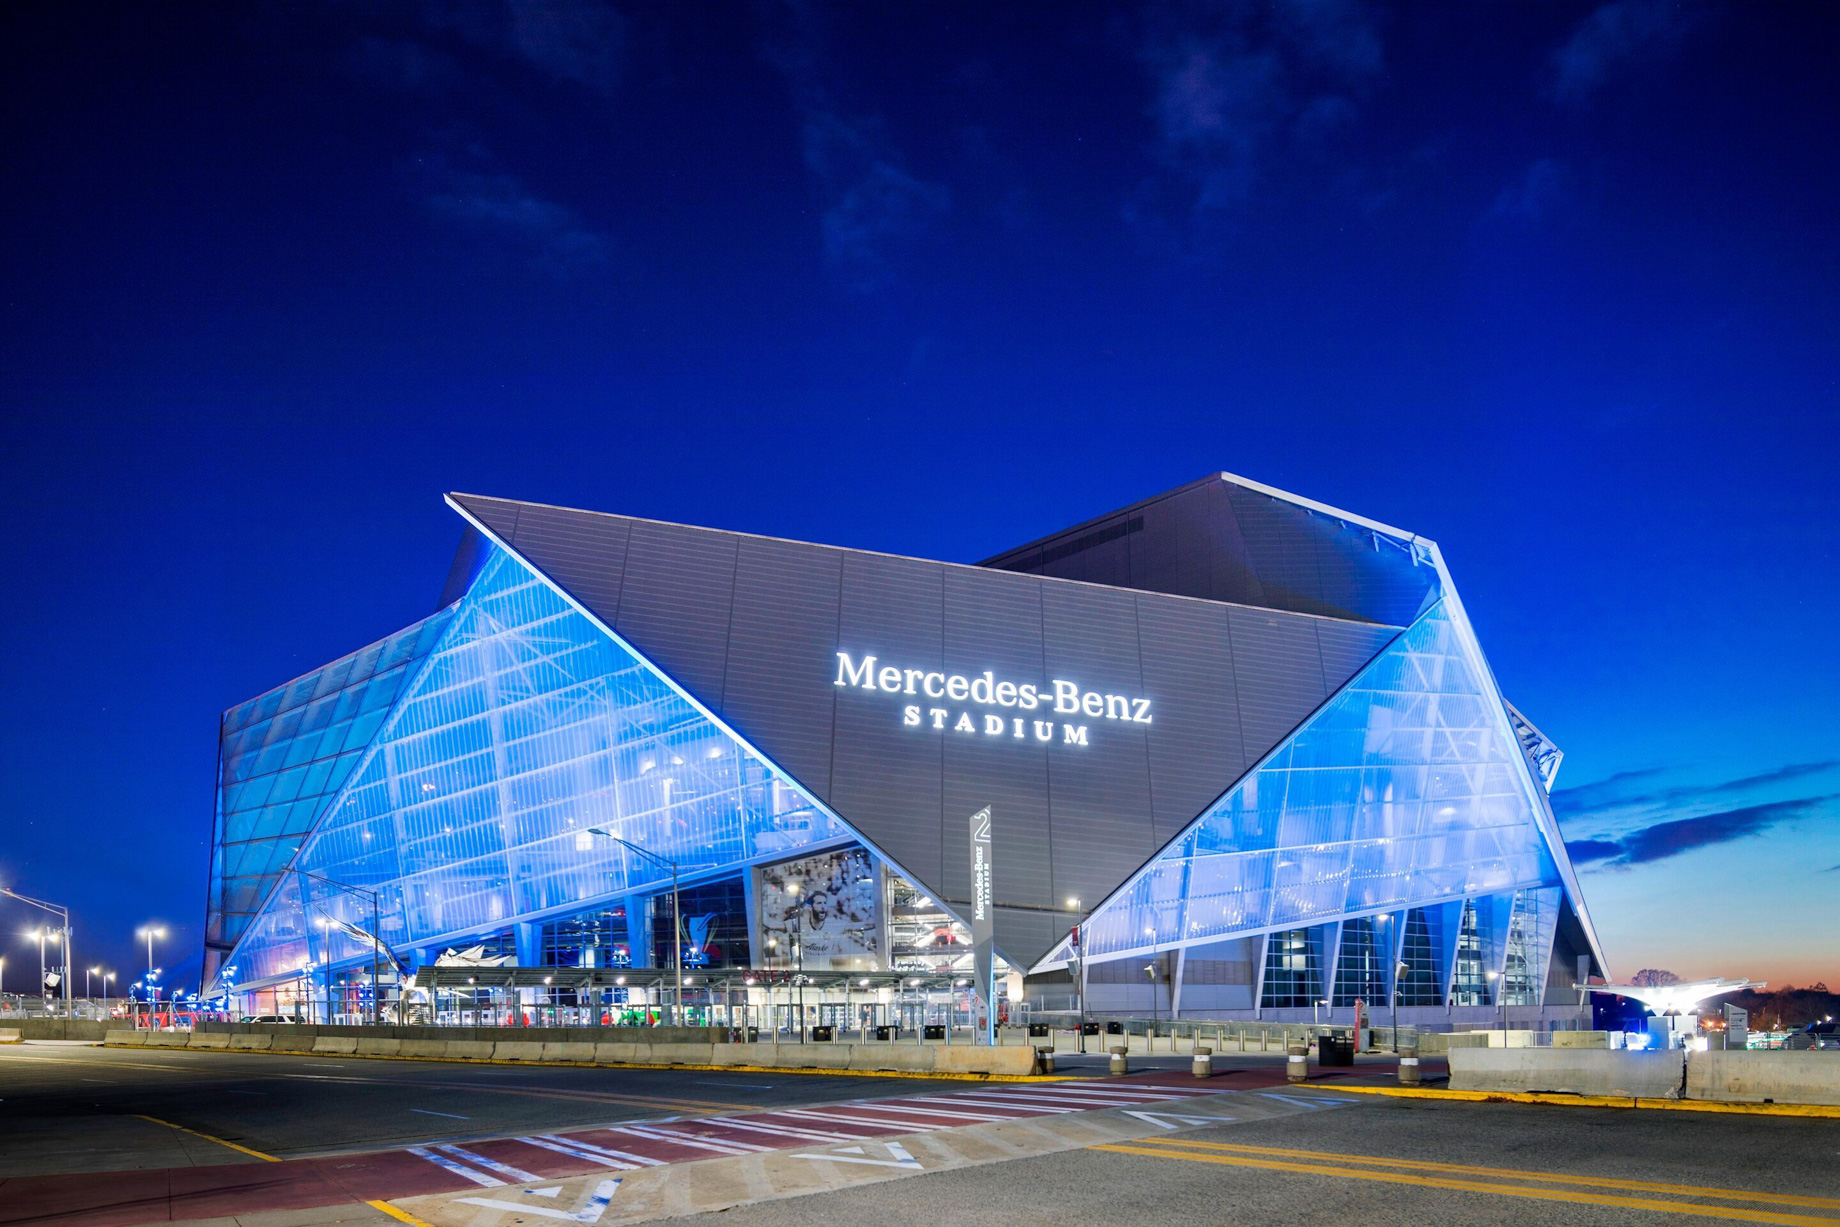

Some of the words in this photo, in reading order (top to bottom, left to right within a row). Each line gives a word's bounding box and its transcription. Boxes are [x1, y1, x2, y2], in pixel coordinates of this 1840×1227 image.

[834, 652, 1152, 723] Mercedes-Benz
[904, 705, 1088, 745] STADIUM
[974, 808, 991, 843] 2
[974, 846, 984, 920] Mercedes-Benz
[742, 969, 778, 983] GATE
[782, 970, 790, 982] 2
